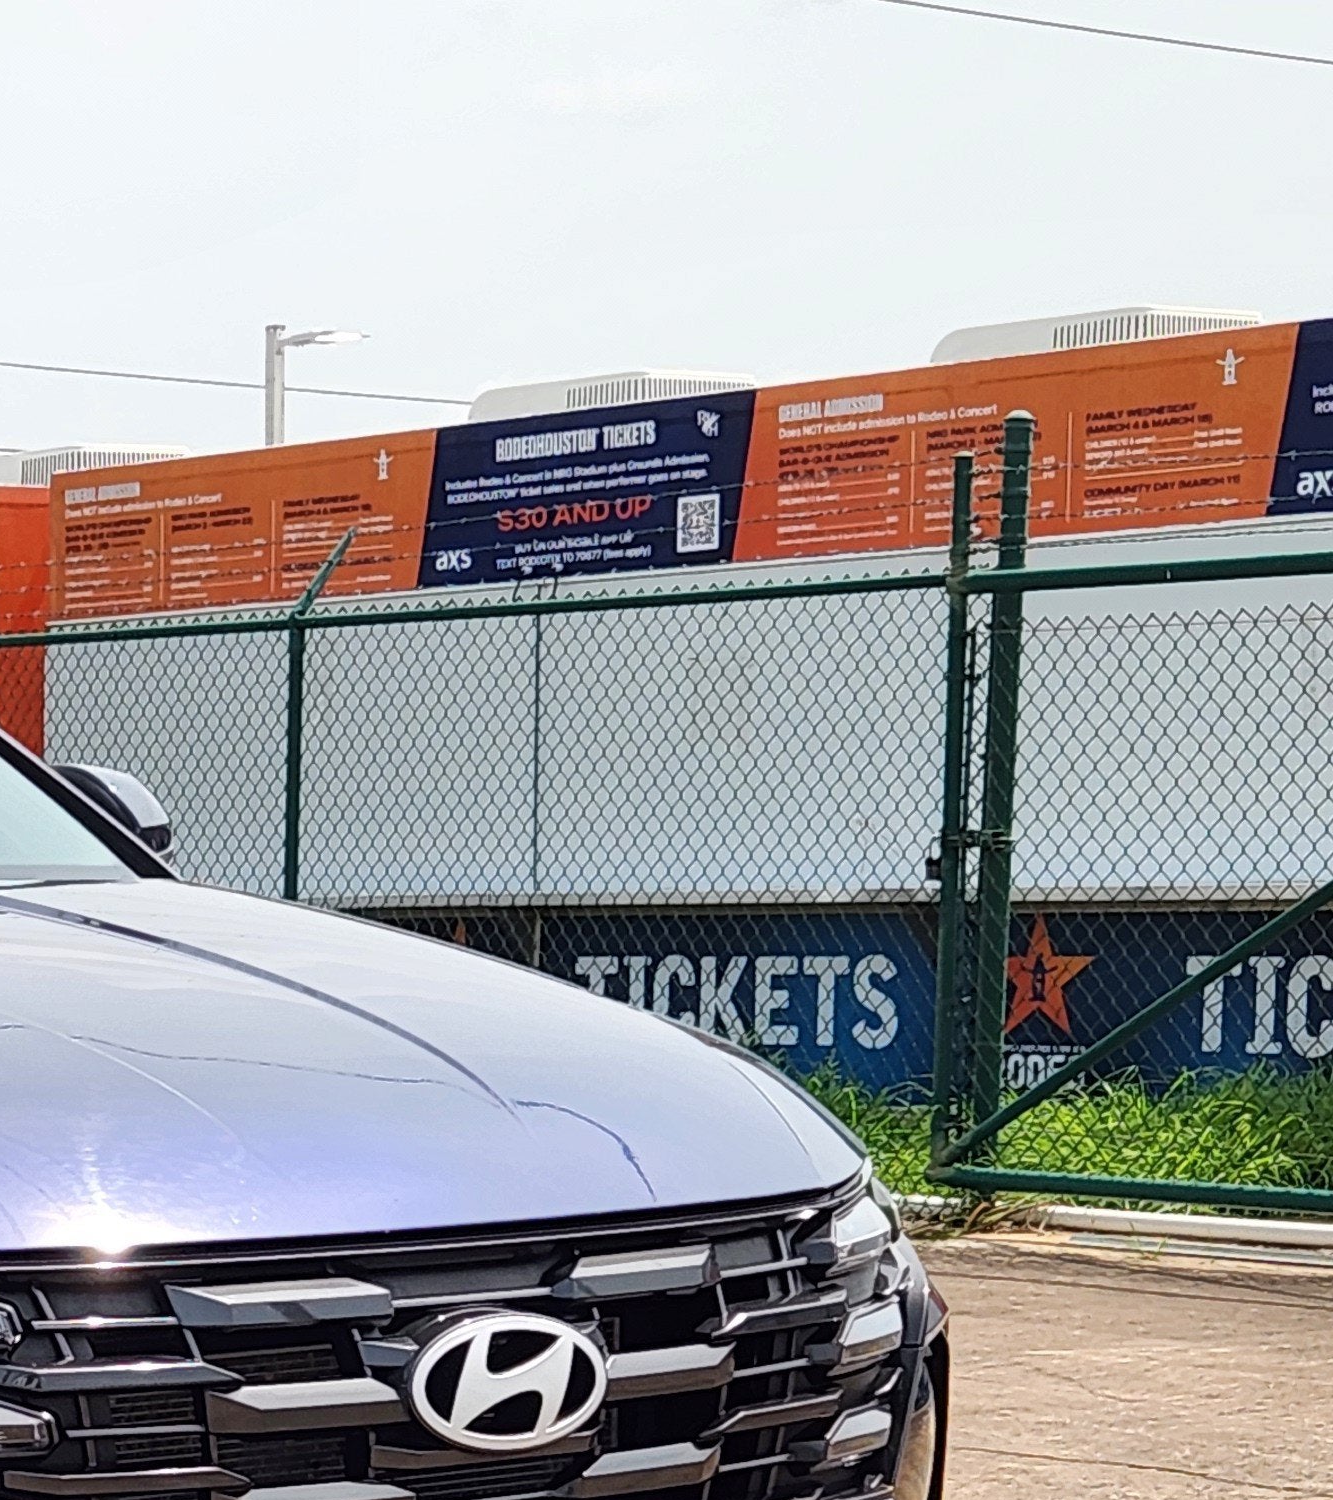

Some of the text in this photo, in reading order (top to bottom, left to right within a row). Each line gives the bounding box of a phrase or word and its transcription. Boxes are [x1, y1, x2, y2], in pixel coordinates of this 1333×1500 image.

[601, 420, 656, 450] TICKETS
[779, 427, 801, 439] Does
[802, 423, 822, 436] NOT
[823, 421, 857, 434] include
[858, 416, 904, 431] admission
[907, 413, 916, 424] to
[918, 411, 947, 422] Rodeo
[957, 404, 998, 418] Concert
[1084, 483, 1152, 498] COMMUNITY
[1153, 481, 1175, 492] DAY
[1296, 470, 1333, 497] ax
[552, 500, 610, 527] AND
[615, 495, 652, 519] UP
[435, 550, 471, 571] axs
[496, 557, 518, 570] TEXT
[575, 954, 899, 1049] TICKETS
